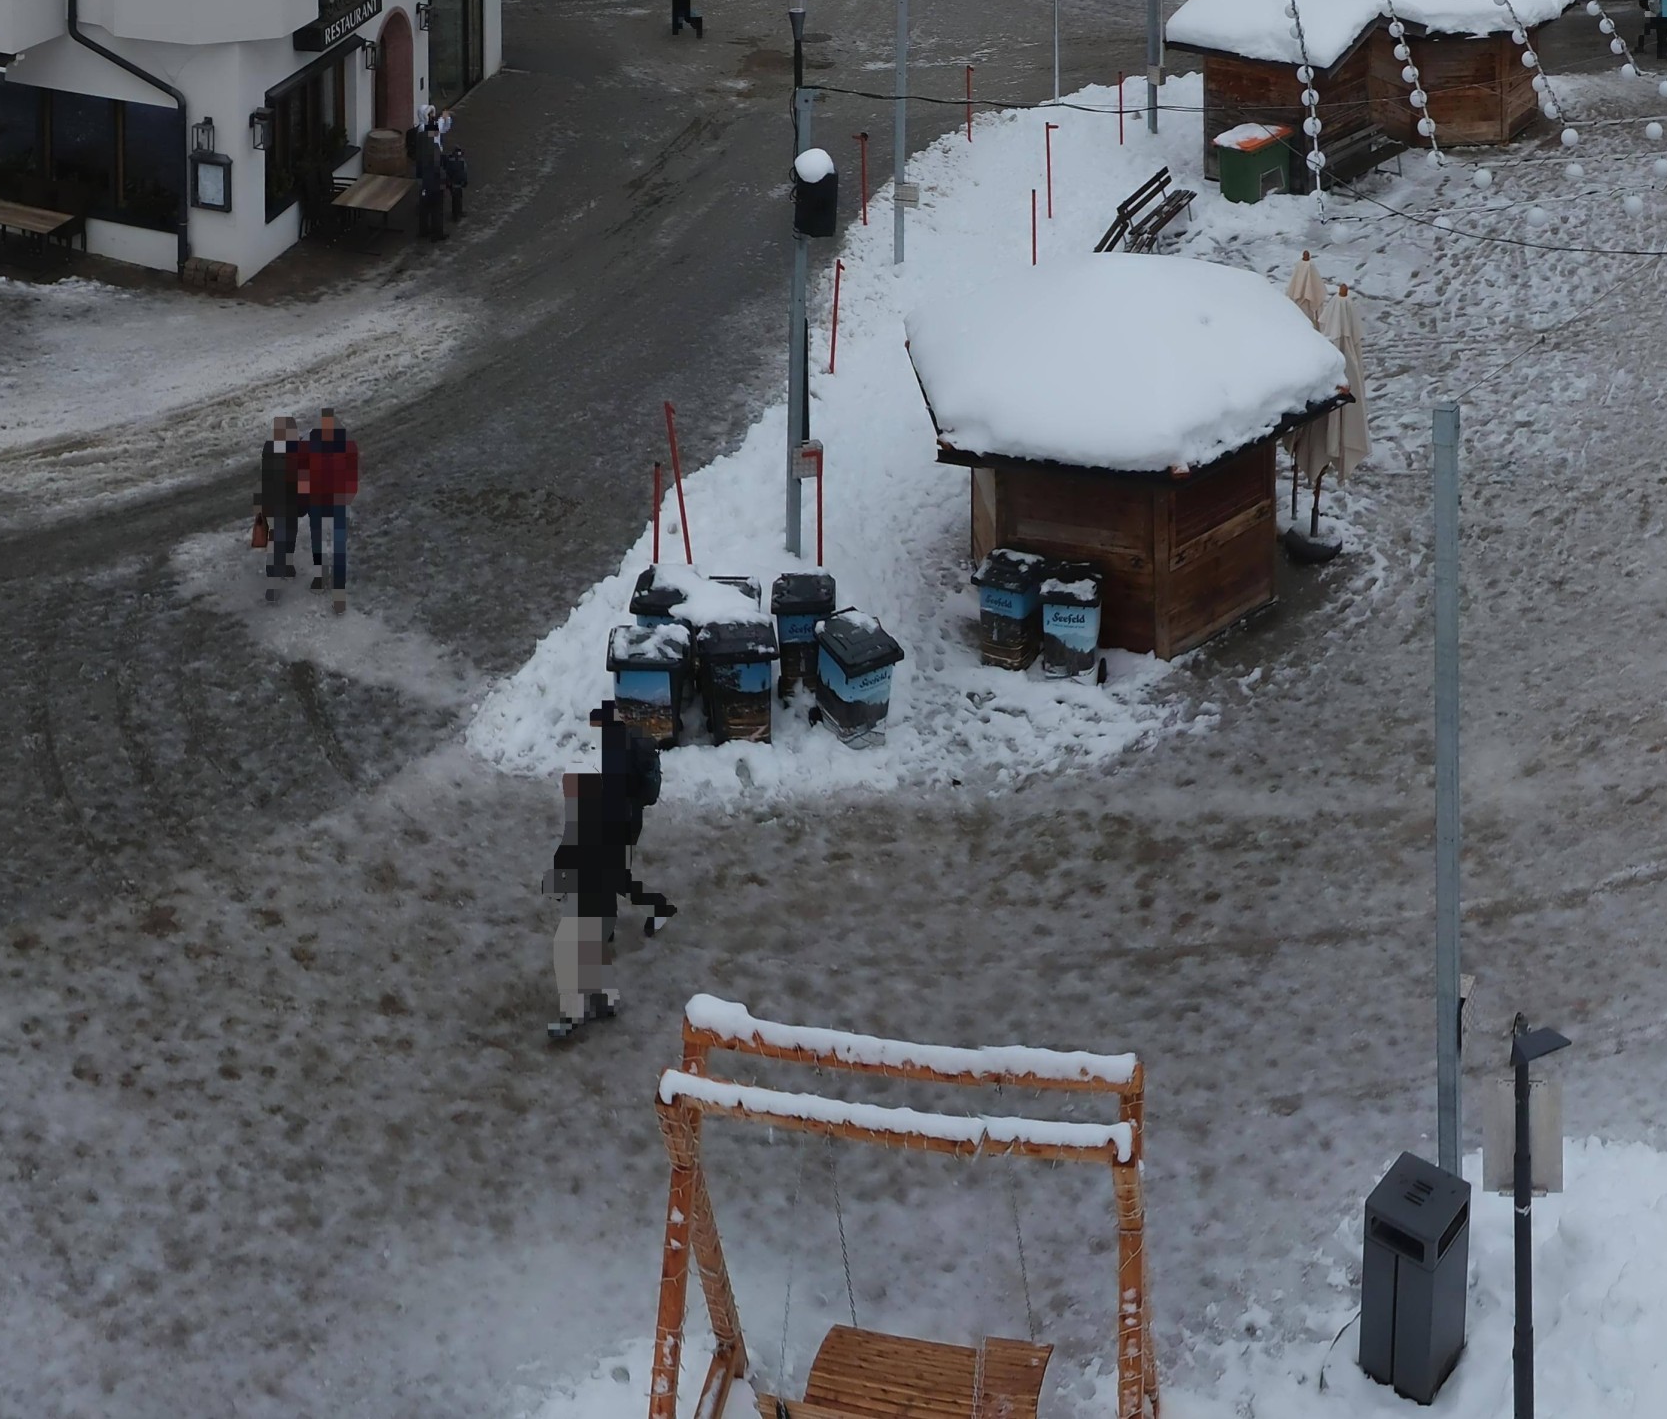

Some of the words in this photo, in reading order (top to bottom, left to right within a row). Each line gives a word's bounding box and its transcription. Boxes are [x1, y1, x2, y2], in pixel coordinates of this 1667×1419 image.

[984, 594, 1013, 608] Seefeld
[1052, 612, 1086, 624] Seefeld
[859, 671, 888, 688] Seefeld
